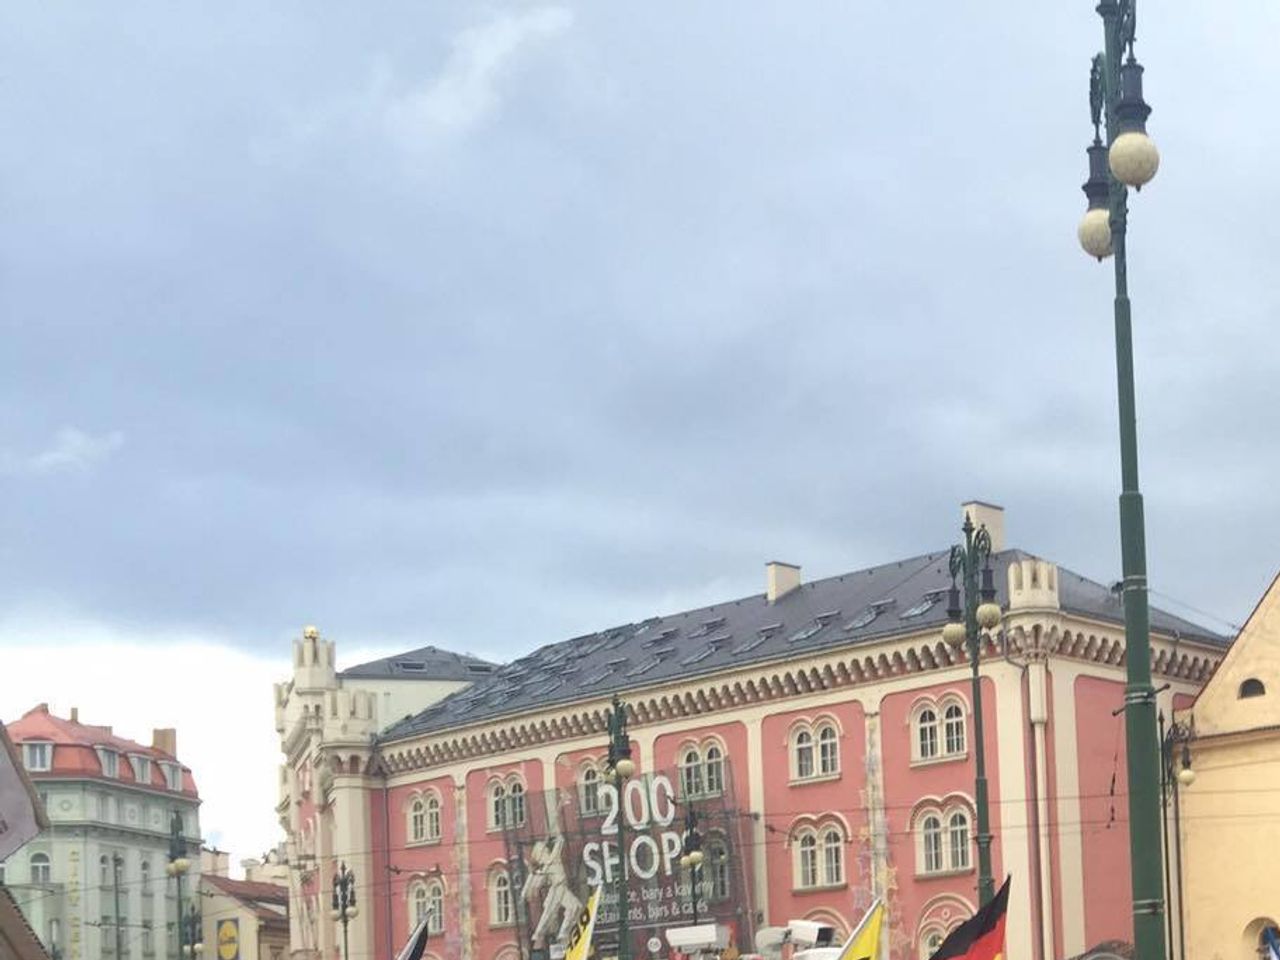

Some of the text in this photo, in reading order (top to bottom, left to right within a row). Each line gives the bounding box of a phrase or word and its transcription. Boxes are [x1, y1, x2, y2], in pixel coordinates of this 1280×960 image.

[596, 775, 676, 835] 200
[582, 830, 692, 887] SHOP
[682, 897, 709, 914] caés
